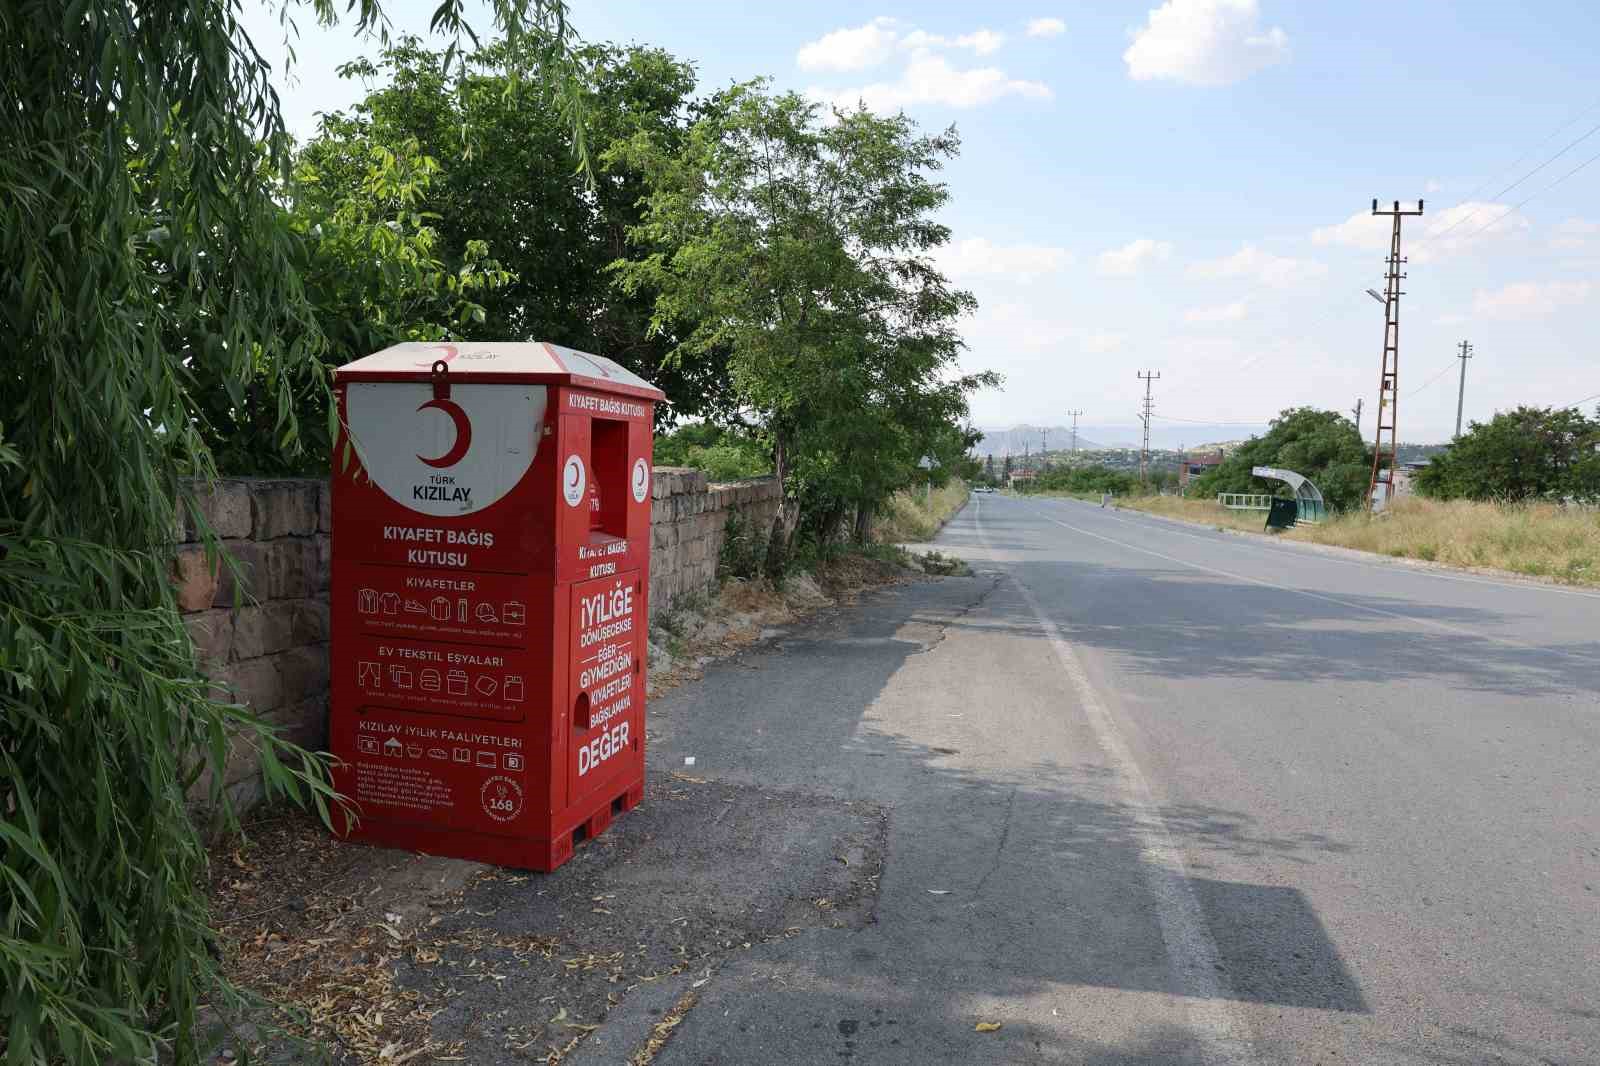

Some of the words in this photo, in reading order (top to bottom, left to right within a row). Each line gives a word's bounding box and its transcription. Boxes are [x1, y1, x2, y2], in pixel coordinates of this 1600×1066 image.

[569, 393, 598, 411] KIYAFET
[621, 402, 645, 417] KUTUSU
[430, 475, 455, 485] TÜRK
[413, 485, 471, 501] KIZILAY
[383, 526, 443, 543] KIYAFET
[447, 528, 494, 547] BAĞIŞ
[408, 550, 467, 566] KUTUSU
[590, 561, 616, 578] KUTUSU
[406, 577, 476, 591] KIYAFETLER
[581, 581, 633, 629] İYİLİĞE
[379, 646, 394, 656] EV
[399, 648, 443, 662] TEKSTİL
[447, 652, 504, 667] EŞYALARI
[598, 643, 617, 663] EĞER
[580, 651, 632, 689] GİYMEDİĞİN
[359, 720, 401, 734] KIZILAY
[578, 721, 629, 776] DEĞER
[490, 798, 513, 811] 168
